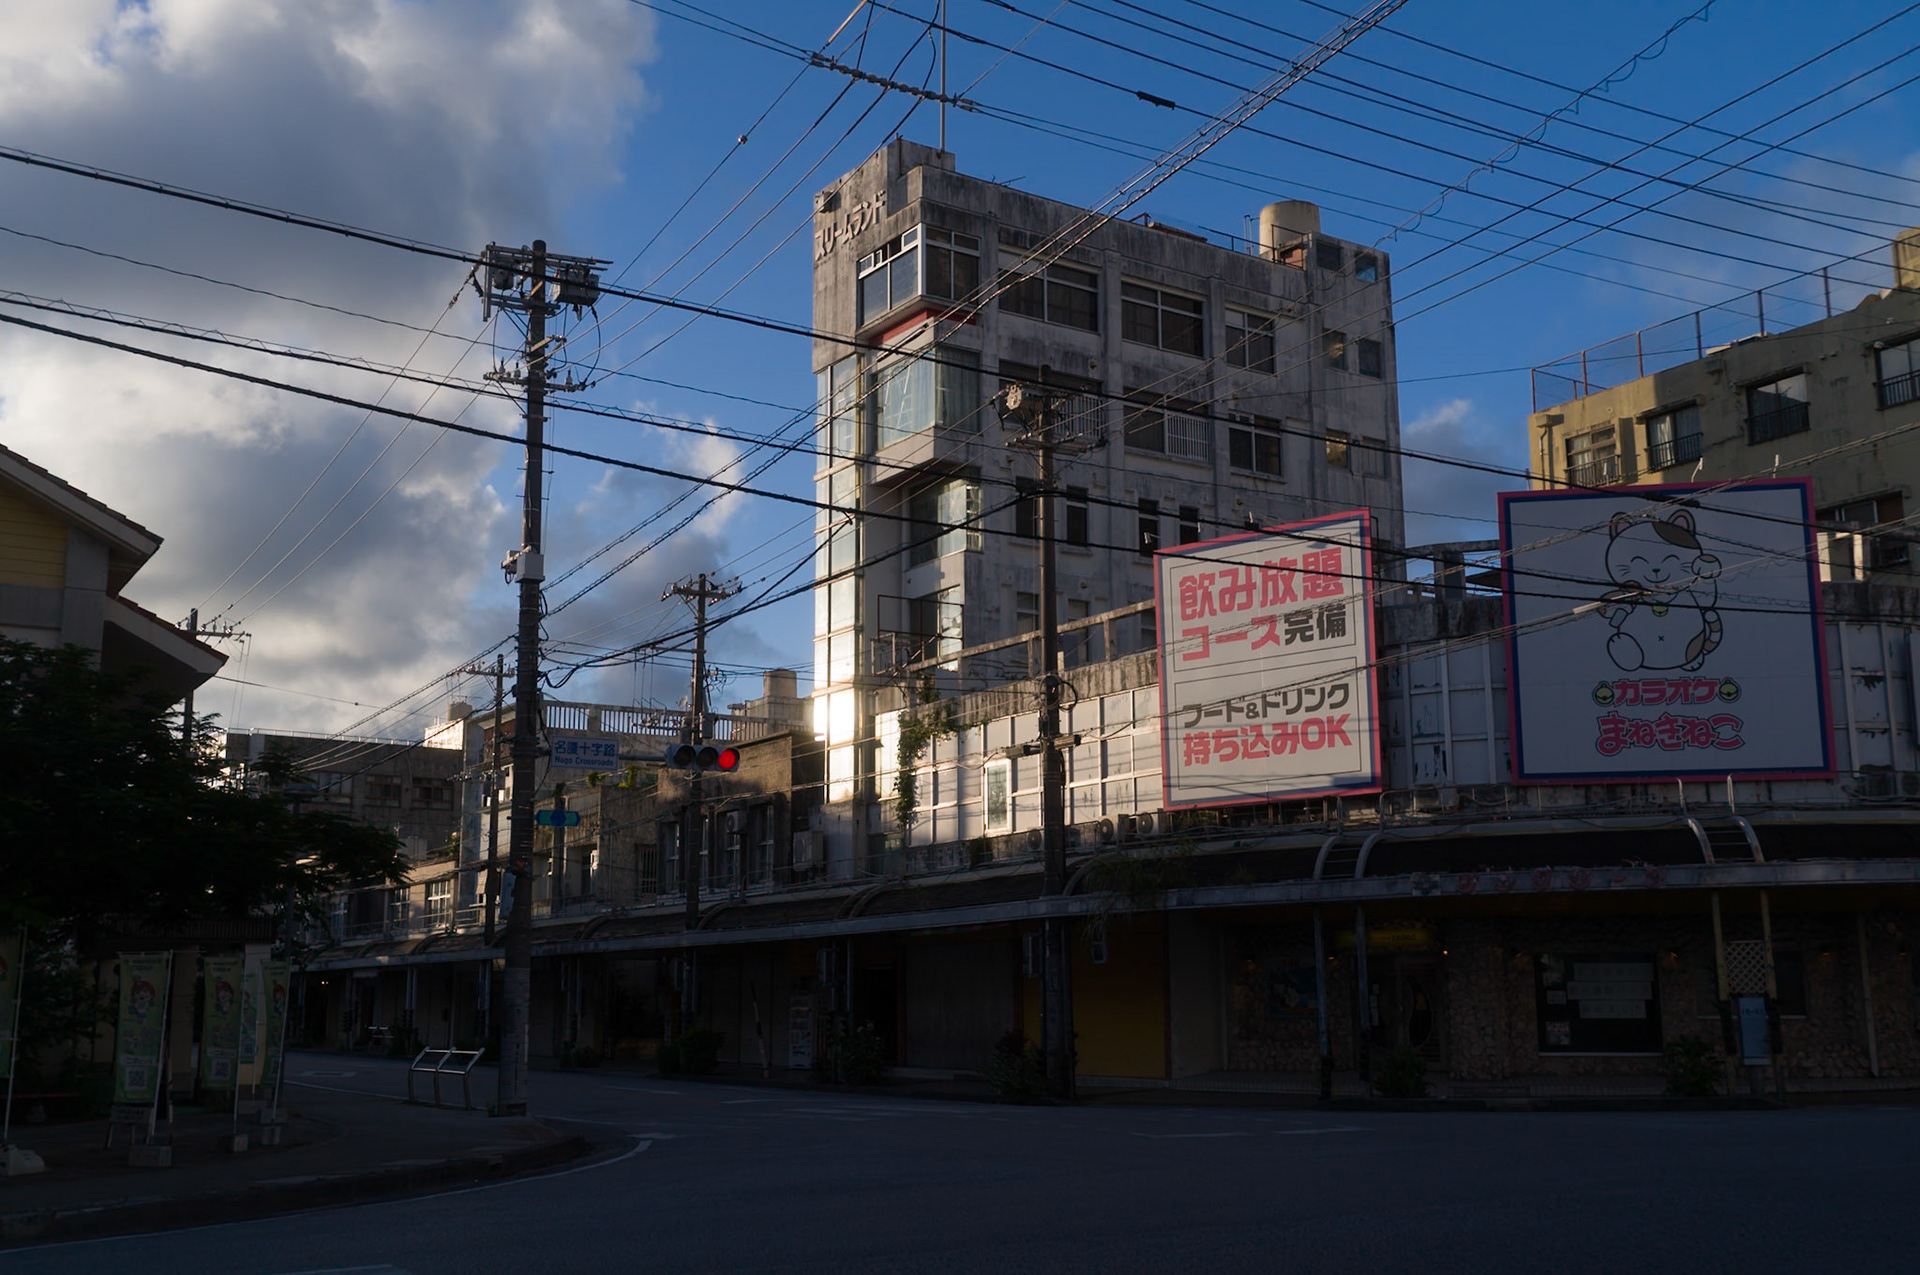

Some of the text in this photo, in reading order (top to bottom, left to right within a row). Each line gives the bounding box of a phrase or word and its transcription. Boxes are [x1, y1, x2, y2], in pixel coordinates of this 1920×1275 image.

[1178, 546, 1345, 622] 飲み放題
[1181, 605, 1347, 661] コース完備
[1183, 682, 1349, 728] フード&ドリンク
[1613, 677, 1719, 706] カラオケ
[554, 741, 615, 757] 名護十字路
[1183, 712, 1353, 767] 持ち込みOK
[1595, 711, 1745, 757] まねきねこ
[554, 755, 613, 766] Nago Crossroads
